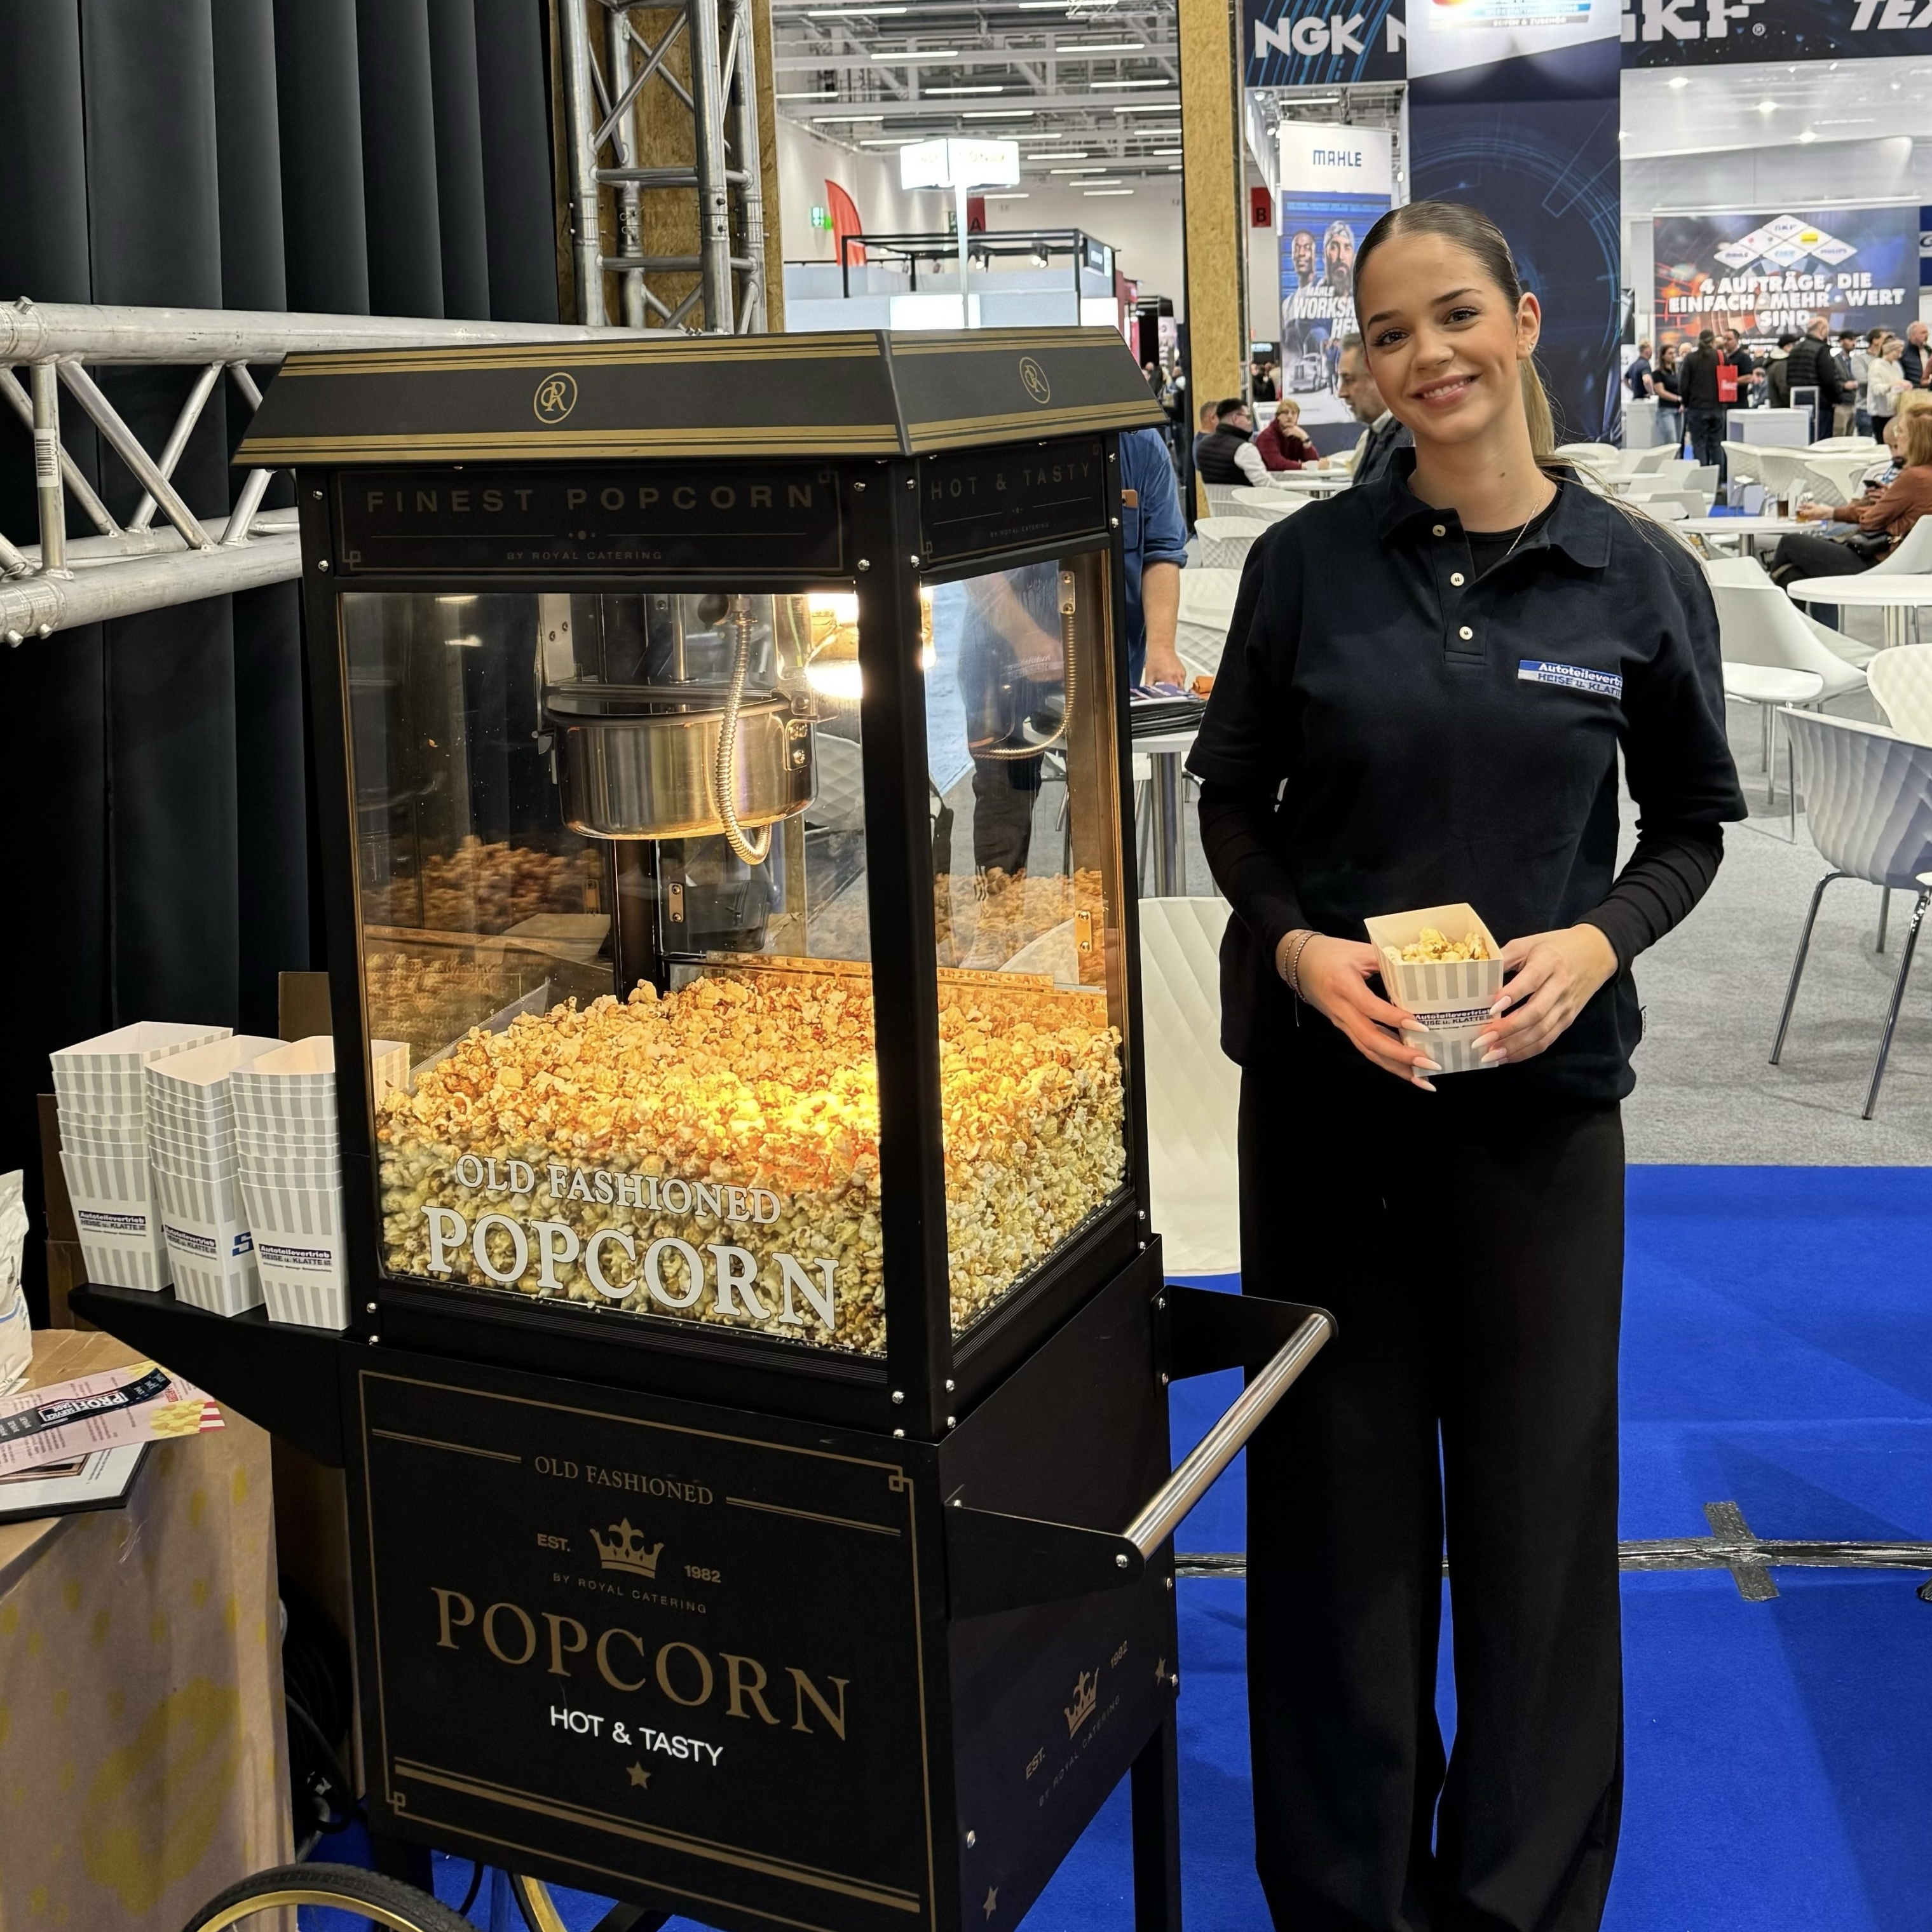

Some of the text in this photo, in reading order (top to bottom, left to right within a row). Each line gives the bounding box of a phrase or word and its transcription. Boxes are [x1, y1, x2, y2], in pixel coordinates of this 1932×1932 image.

[1621, 0, 1765, 43] KF
[1255, 13, 1366, 58] NGK
[1313, 149, 1362, 167] MAHLE
[970, 217, 982, 231] A
[1255, 207, 1267, 222] B
[1306, 286, 1335, 297] MAHLE
[1699, 271, 1872, 294] 4 AUFTRÄGE, DIE
[1668, 289, 1906, 313] EINFACH MEHR WERT
[1759, 310, 1810, 327] SIND
[931, 461, 1089, 500] HOT & TASTY
[367, 485, 812, 512] FINEST POPCORN
[533, 552, 579, 560] ROYAL
[587, 552, 662, 560] CATERING
[1538, 673, 1574, 685] HEISE
[456, 1153, 782, 1225] OLD FASHIONED
[80, 1212, 145, 1223] Autoteilevertrieb
[187, 1242, 210, 1253] KLATTE
[261, 1245, 330, 1258] Autoteilevertrieb
[261, 1253, 283, 1262] HEISE
[292, 1257, 323, 1265] KLATTE
[419, 1204, 840, 1331] POPCORN
[534, 1455, 714, 1506] OLD FASHIONED
[537, 1533, 722, 1584] EST. 1982
[553, 1572, 707, 1614] BY ROYAL CATERING
[430, 1587, 850, 1741] POPCORN
[1110, 1640, 1128, 1670] 1982
[1082, 1694, 1120, 1749] CATERING
[550, 1705, 724, 1767] HOT & TASTY
[1026, 1746, 1045, 1781] EST.
